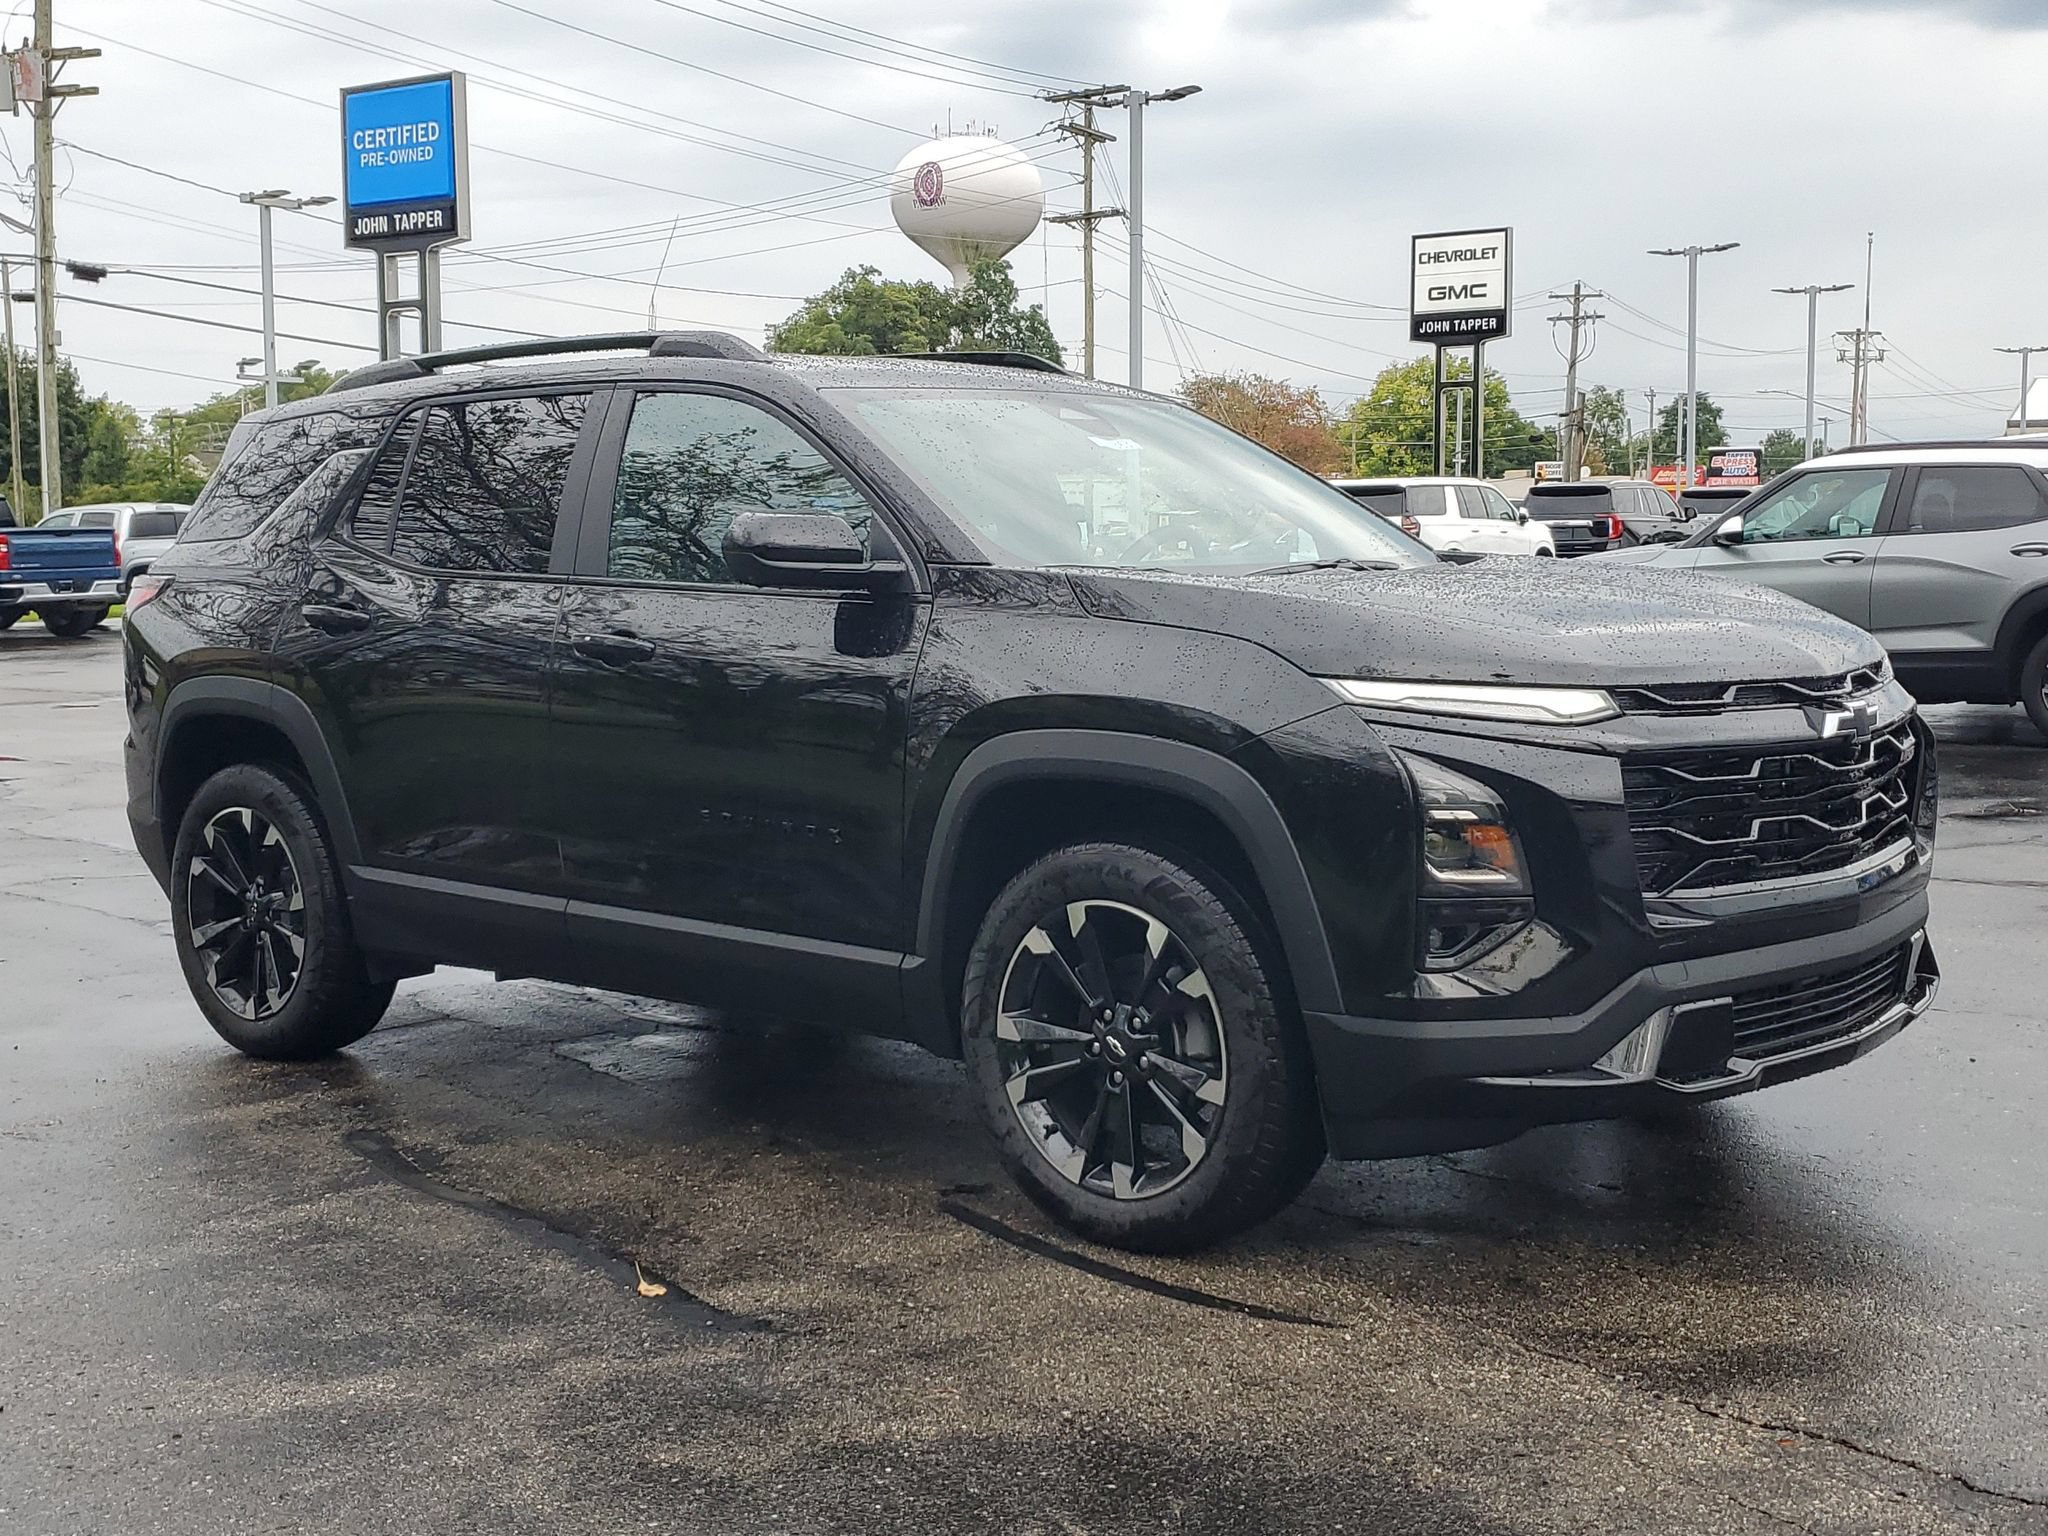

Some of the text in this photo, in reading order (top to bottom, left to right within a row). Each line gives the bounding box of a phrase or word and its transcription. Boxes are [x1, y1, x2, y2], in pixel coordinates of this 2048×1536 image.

[353, 121, 440, 150] CERTIFIED
[360, 146, 434, 168] PRE-OWNED
[354, 209, 443, 235] JOHN TAPPER
[1418, 246, 1499, 265] CHEVROLET
[1428, 283, 1488, 301] GMC
[1419, 317, 1497, 333] JOHN TAPPER
[1712, 457, 1755, 467] EXPRESS
